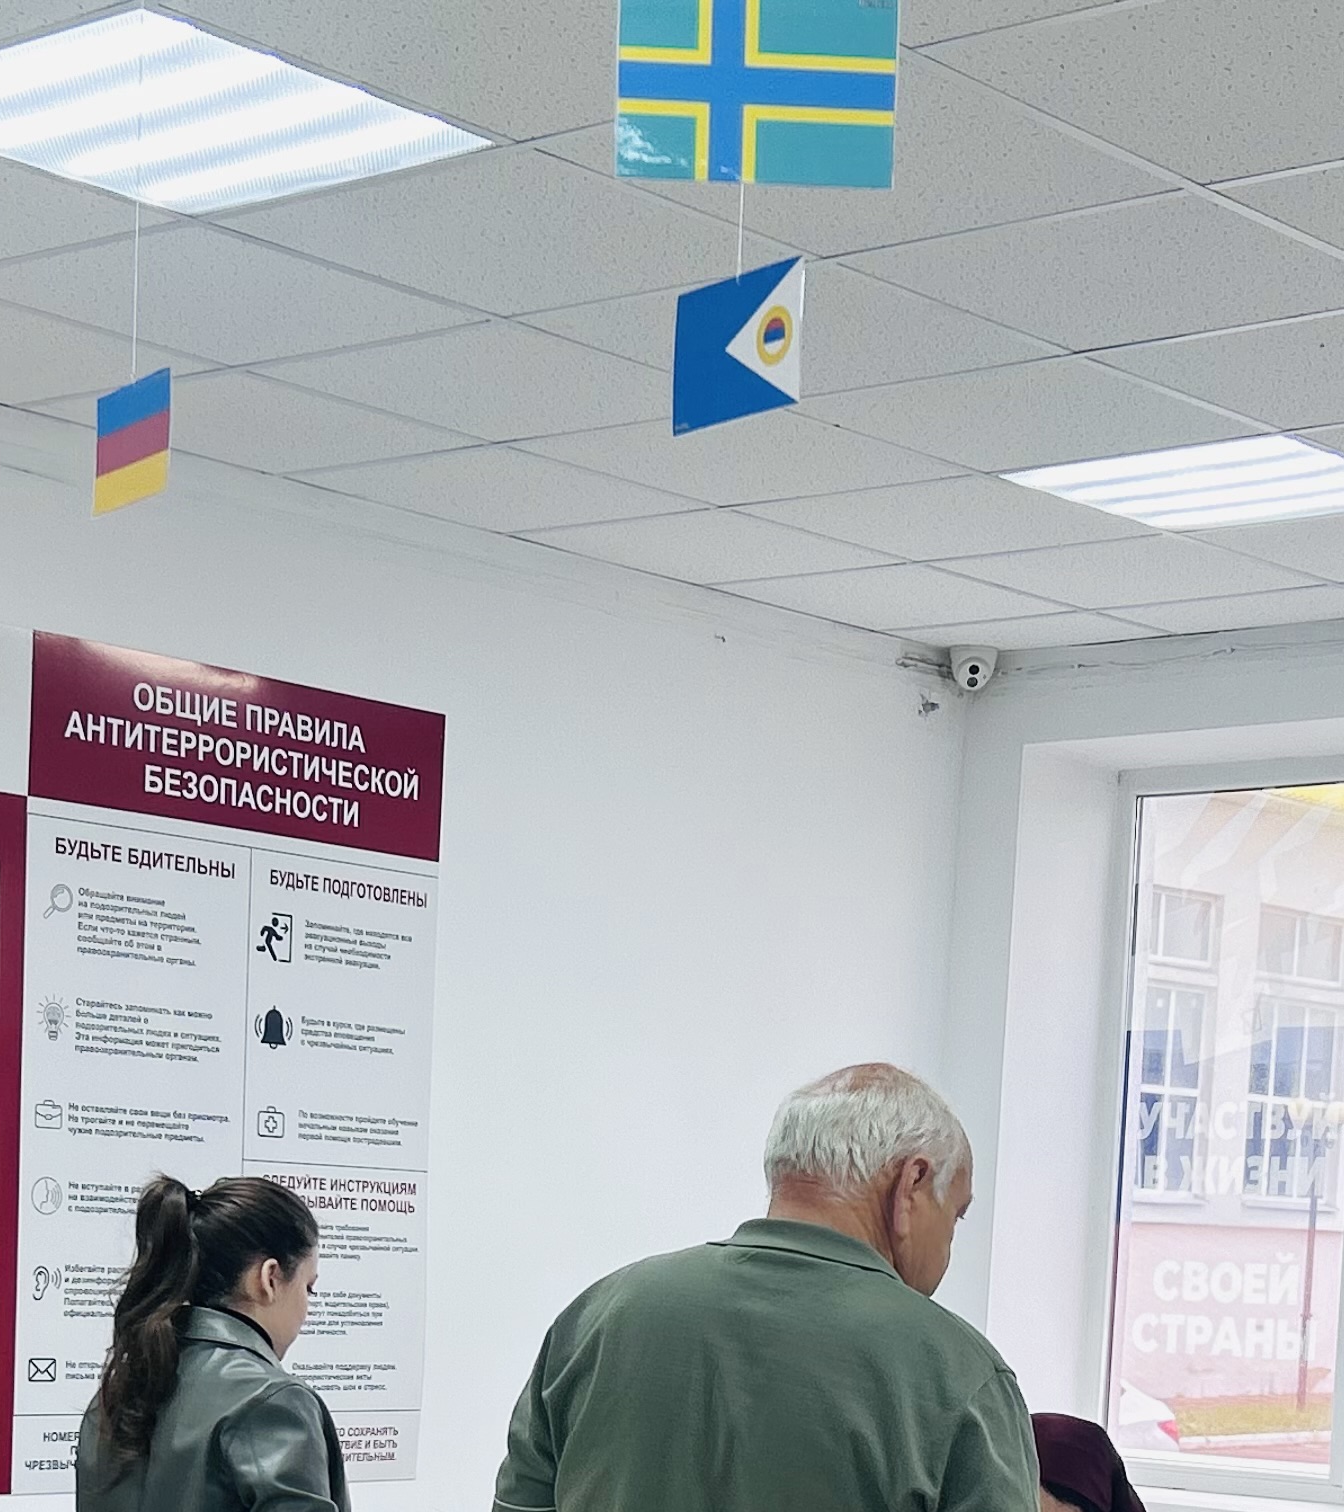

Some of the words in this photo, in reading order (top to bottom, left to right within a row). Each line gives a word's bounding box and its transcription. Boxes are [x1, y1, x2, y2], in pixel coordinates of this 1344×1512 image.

[132, 682, 238, 728] ОБЩИЕ
[246, 705, 365, 754] ПРАВИЛА
[64, 711, 420, 802] АНТИТЕРРОРИСТИЧЕСКОЙ
[144, 764, 360, 828] БЕЗОПАСНОСТИ
[56, 837, 122, 865] БУДЬТЕ
[128, 848, 235, 879] БДИТЕЛЬНЫ
[270, 869, 319, 891] БУДЬТЕ
[322, 877, 428, 908] ПОДГОТОВЛЕНЫ
[1137, 1093, 1339, 1140] УЧАСТВУЙ
[330, 1178, 416, 1196] ИНСТРУКЦИЯМ
[1180, 1155, 1326, 1198] ЖИЗНИ
[361, 1198, 415, 1214] ПОМОЩЬ
[1152, 1252, 1300, 1306] СВОЕЙ
[1131, 1312, 1318, 1362] СТРАНЫ
[348, 1427, 398, 1436] СОХРАНЯТЬ
[365, 1440, 370, 1448] И
